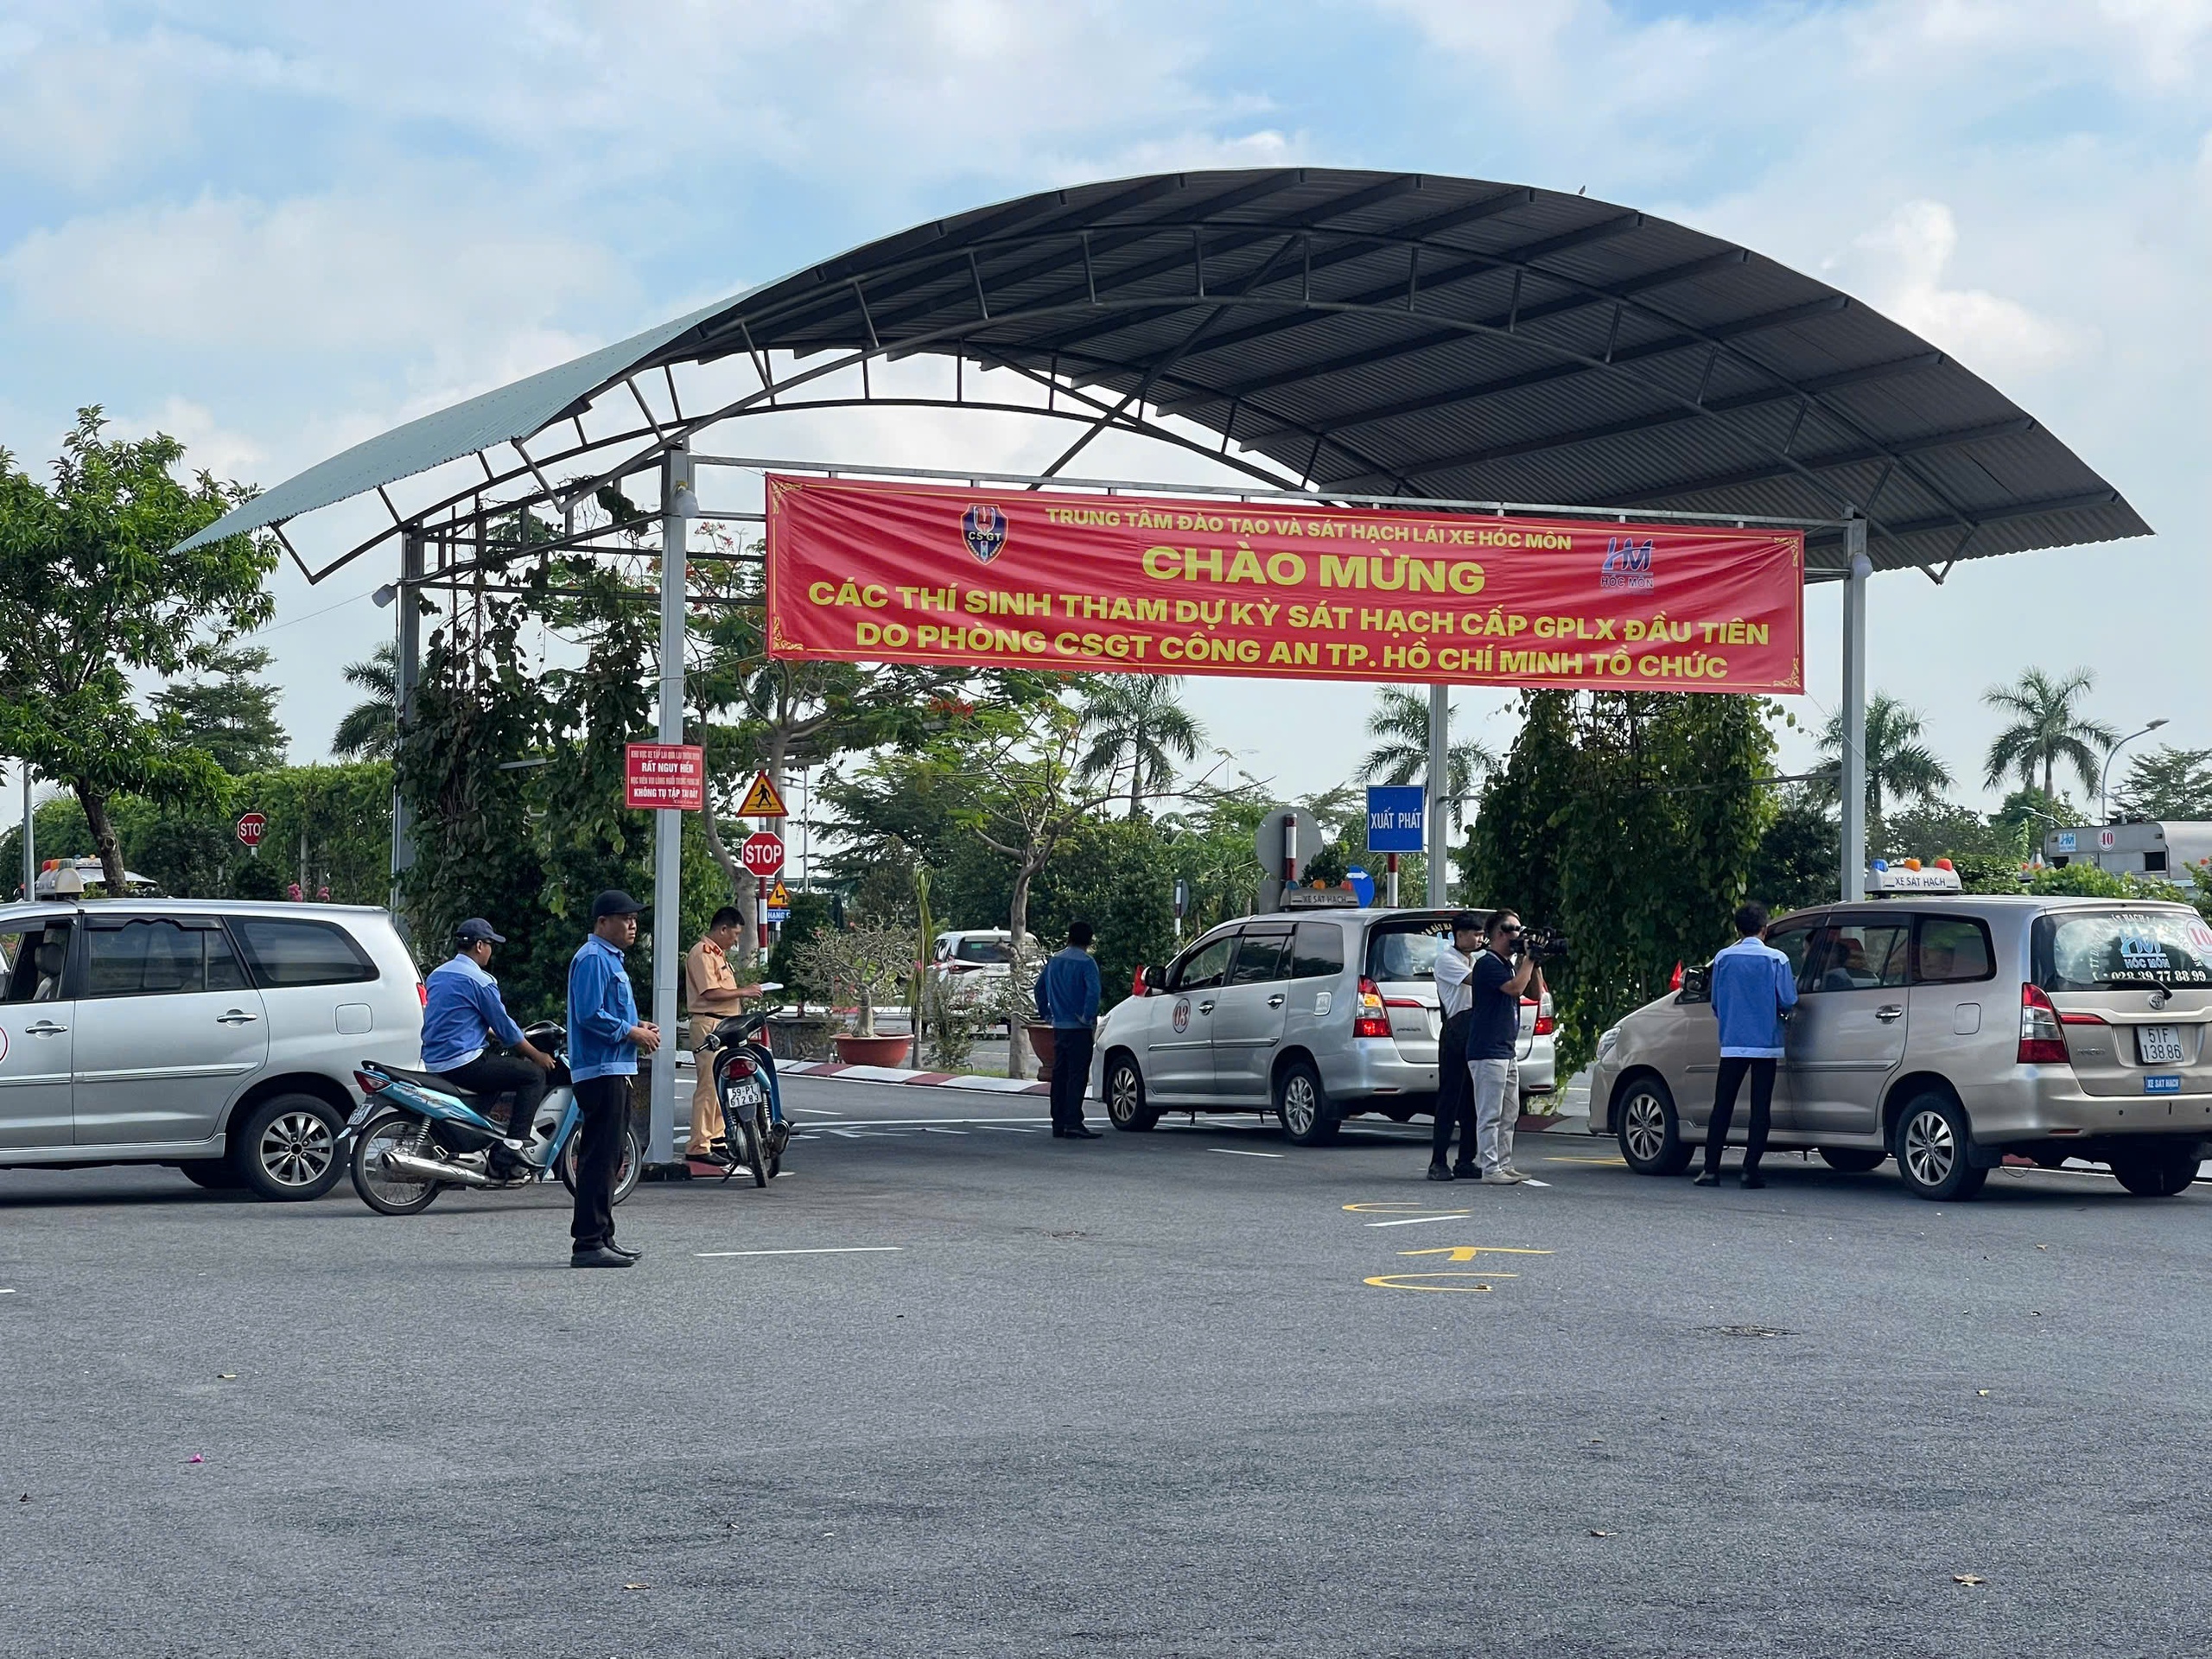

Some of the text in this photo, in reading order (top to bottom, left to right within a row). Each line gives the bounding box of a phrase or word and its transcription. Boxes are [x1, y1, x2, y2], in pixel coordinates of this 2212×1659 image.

[969, 531, 1001, 541] CSGT
[1046, 507, 1572, 550] TRUNG TÂM ĐÀO TẠO VÀ SÁT HẠCH LÁI XE HÓC MÔN
[1141, 542, 1485, 594] CHÀO MỪNG
[808, 577, 1769, 645] CÁC THÍ SINH THAM DỰ KỲ SÁT HẠCH CẤP GPLX ĐẦU TIÊN
[855, 621, 1728, 678] DO PHÒNG CSGT CÔNG AN TP. HỒ CHÍ MINH TỔ CHỨC
[658, 762, 678, 772] NGUY
[1370, 807, 1421, 830] XUẤT PHÁT
[746, 844, 782, 864] STOP
[1895, 877, 1904, 886] XE
[2156, 970, 2171, 982] 77
[2174, 970, 2190, 982] 88
[2191, 970, 2207, 982] 99
[2147, 1028, 2169, 1044] 51F
[2143, 1044, 2182, 1060] 138.86
